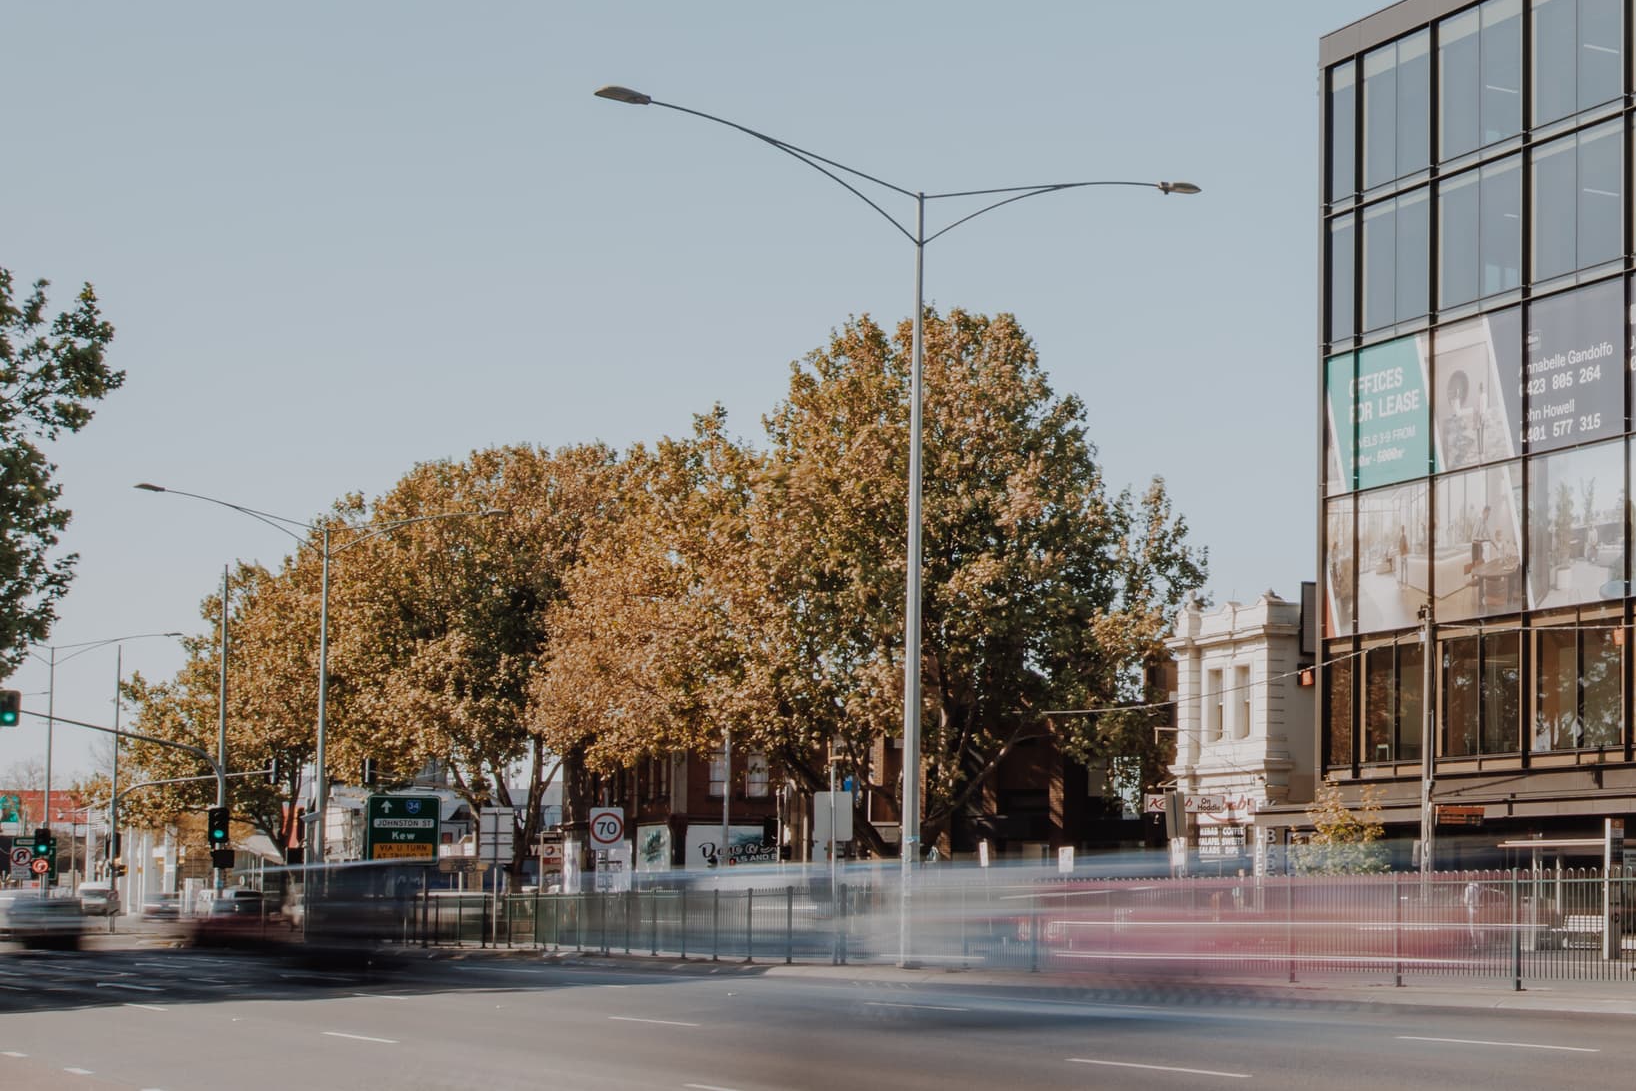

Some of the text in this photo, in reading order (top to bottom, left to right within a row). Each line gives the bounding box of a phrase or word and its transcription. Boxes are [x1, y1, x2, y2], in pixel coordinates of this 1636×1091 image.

[1568, 341, 1613, 364] Gandolfo
[1552, 371, 1573, 390] 805
[1579, 364, 1601, 384] 264
[1379, 389, 1420, 418] LEASE
[1543, 398, 1575, 418] Howell
[1552, 419, 1574, 437] 577
[1579, 412, 1601, 431] 315
[376, 819, 432, 827] JOHNSTON ST
[597, 821, 617, 835] 70
[391, 830, 416, 840] Kew
